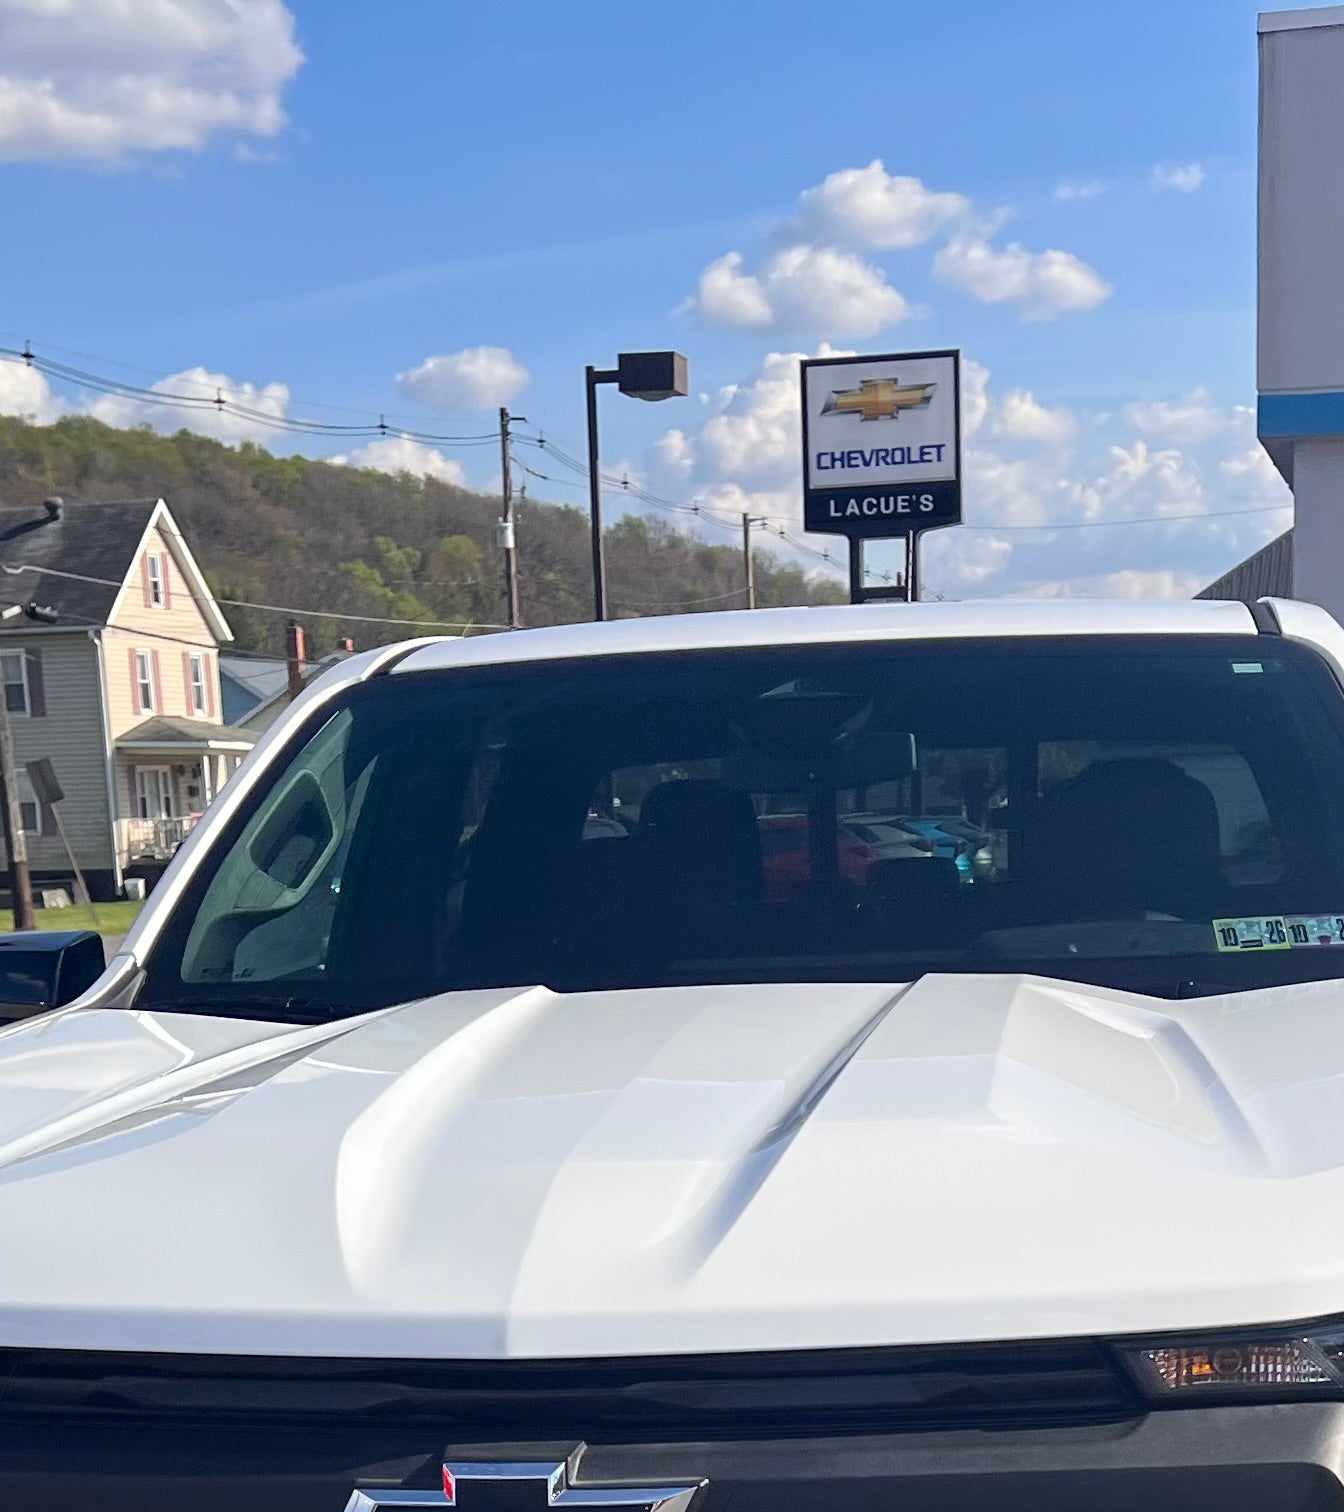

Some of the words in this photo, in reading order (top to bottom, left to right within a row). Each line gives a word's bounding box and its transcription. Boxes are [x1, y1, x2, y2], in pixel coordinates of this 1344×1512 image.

[816, 443, 946, 471] CHEVROLET
[829, 493, 935, 517] LACUE'S
[1218, 926, 1239, 947] 10
[1265, 920, 1286, 944] 26
[1288, 923, 1309, 944] 10
